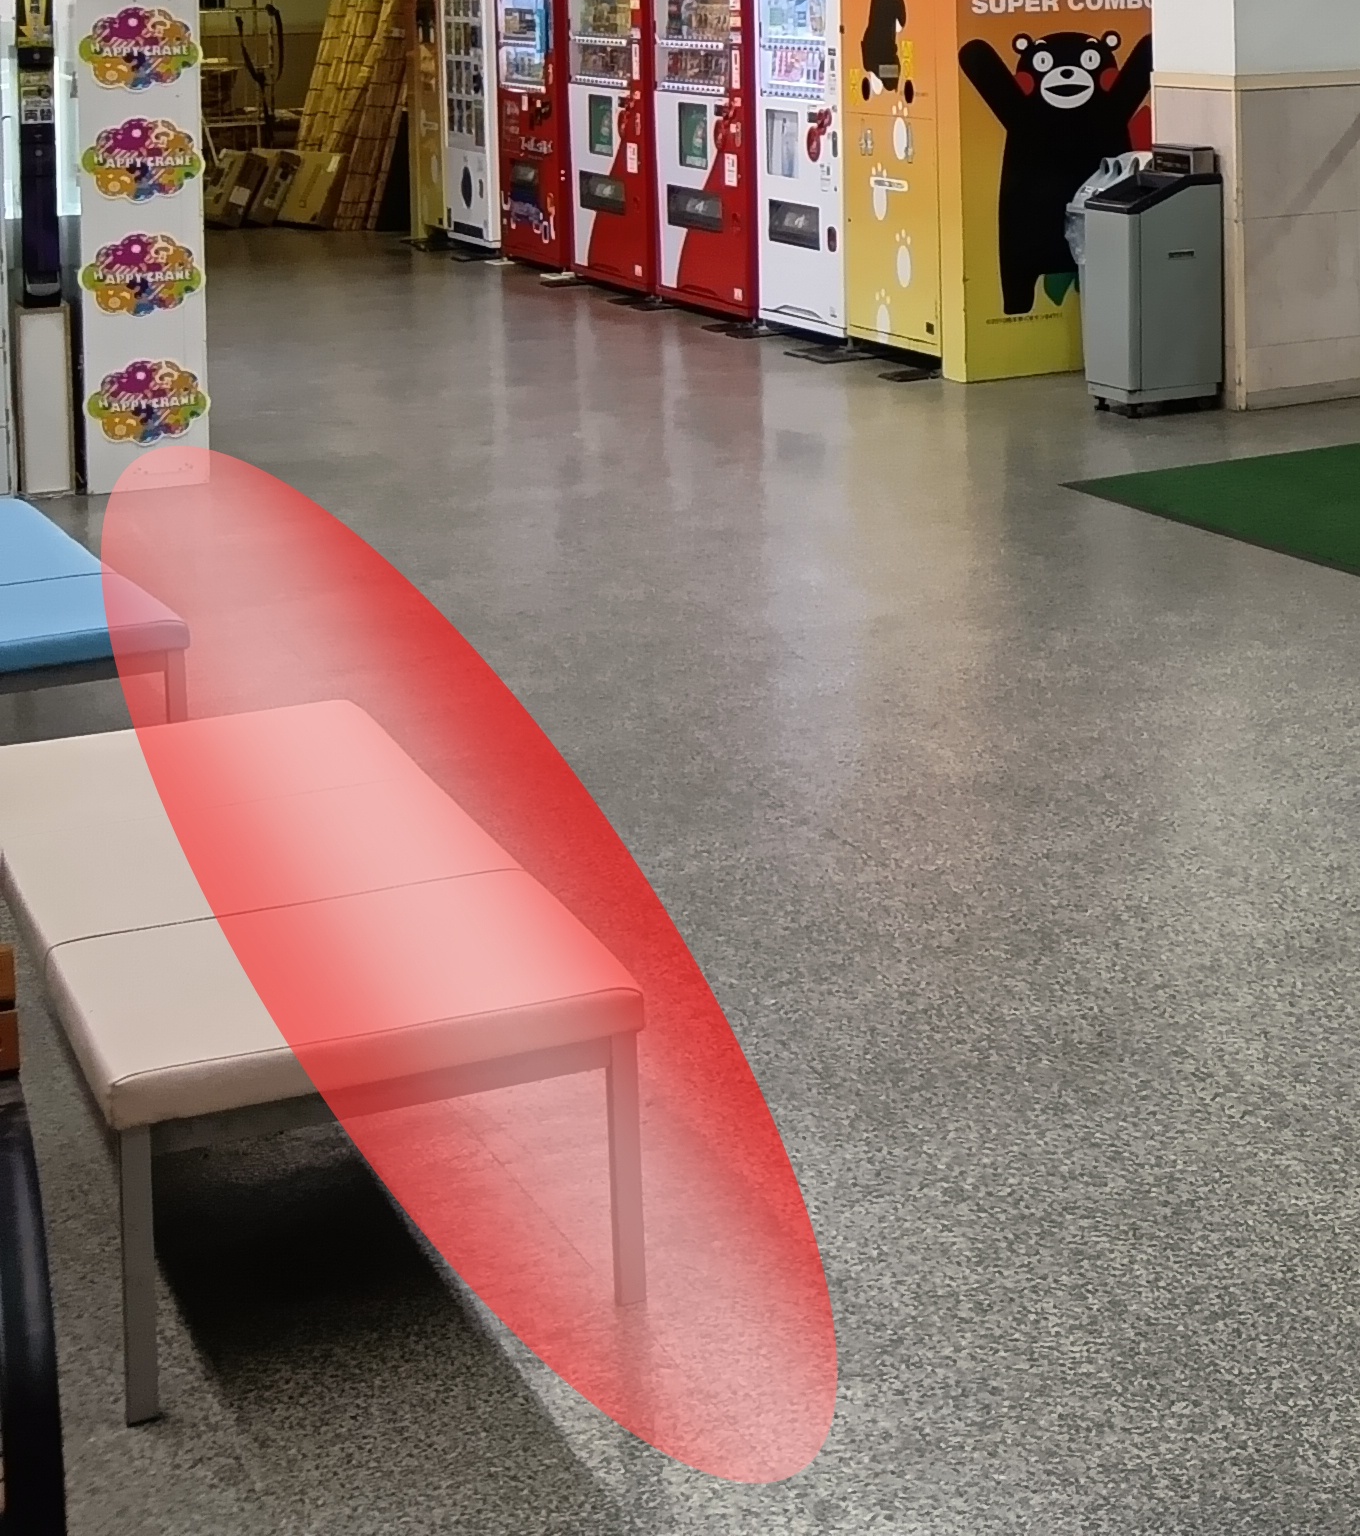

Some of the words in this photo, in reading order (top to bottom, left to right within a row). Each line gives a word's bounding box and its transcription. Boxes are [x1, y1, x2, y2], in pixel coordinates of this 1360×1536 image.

[90, 44, 143, 57] HAPPY
[143, 44, 189, 56] CRANE
[93, 152, 146, 169] HAPPY
[147, 155, 193, 167] CRANE
[93, 270, 147, 286] HAPPY
[147, 270, 192, 283] CRANE
[98, 397, 152, 413] HAPPY
[152, 393, 196, 409] CRANE
